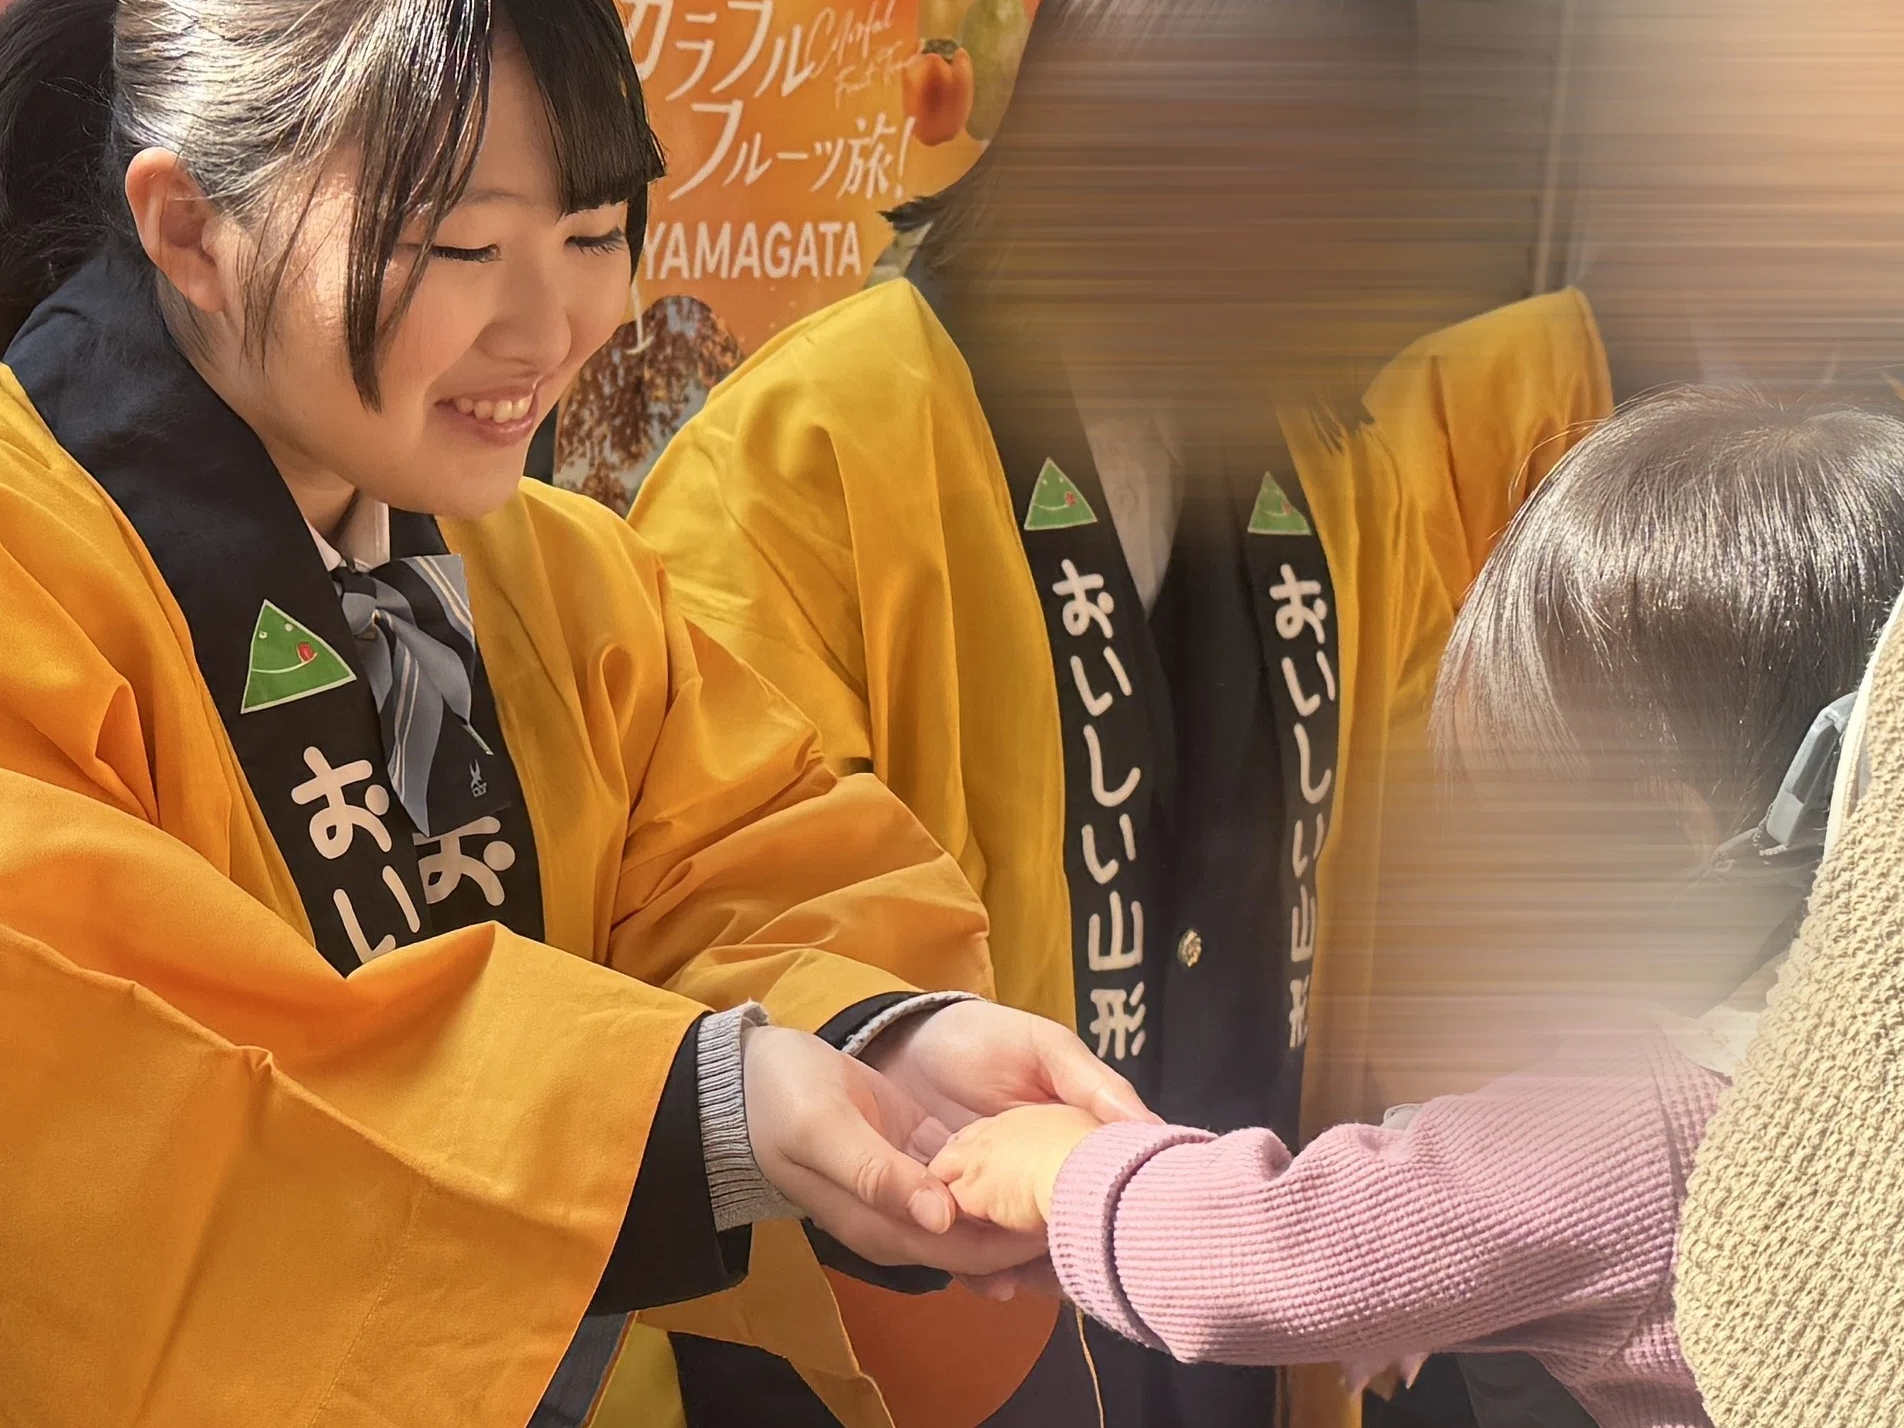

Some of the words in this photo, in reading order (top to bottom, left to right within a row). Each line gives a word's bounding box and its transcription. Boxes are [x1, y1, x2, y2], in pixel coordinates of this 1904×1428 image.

[641, 221, 862, 281] YAMAGATA
[291, 746, 421, 963] おい
[1052, 559, 1145, 1060] おいしい山形
[1269, 564, 1336, 1049] おいしい山形
